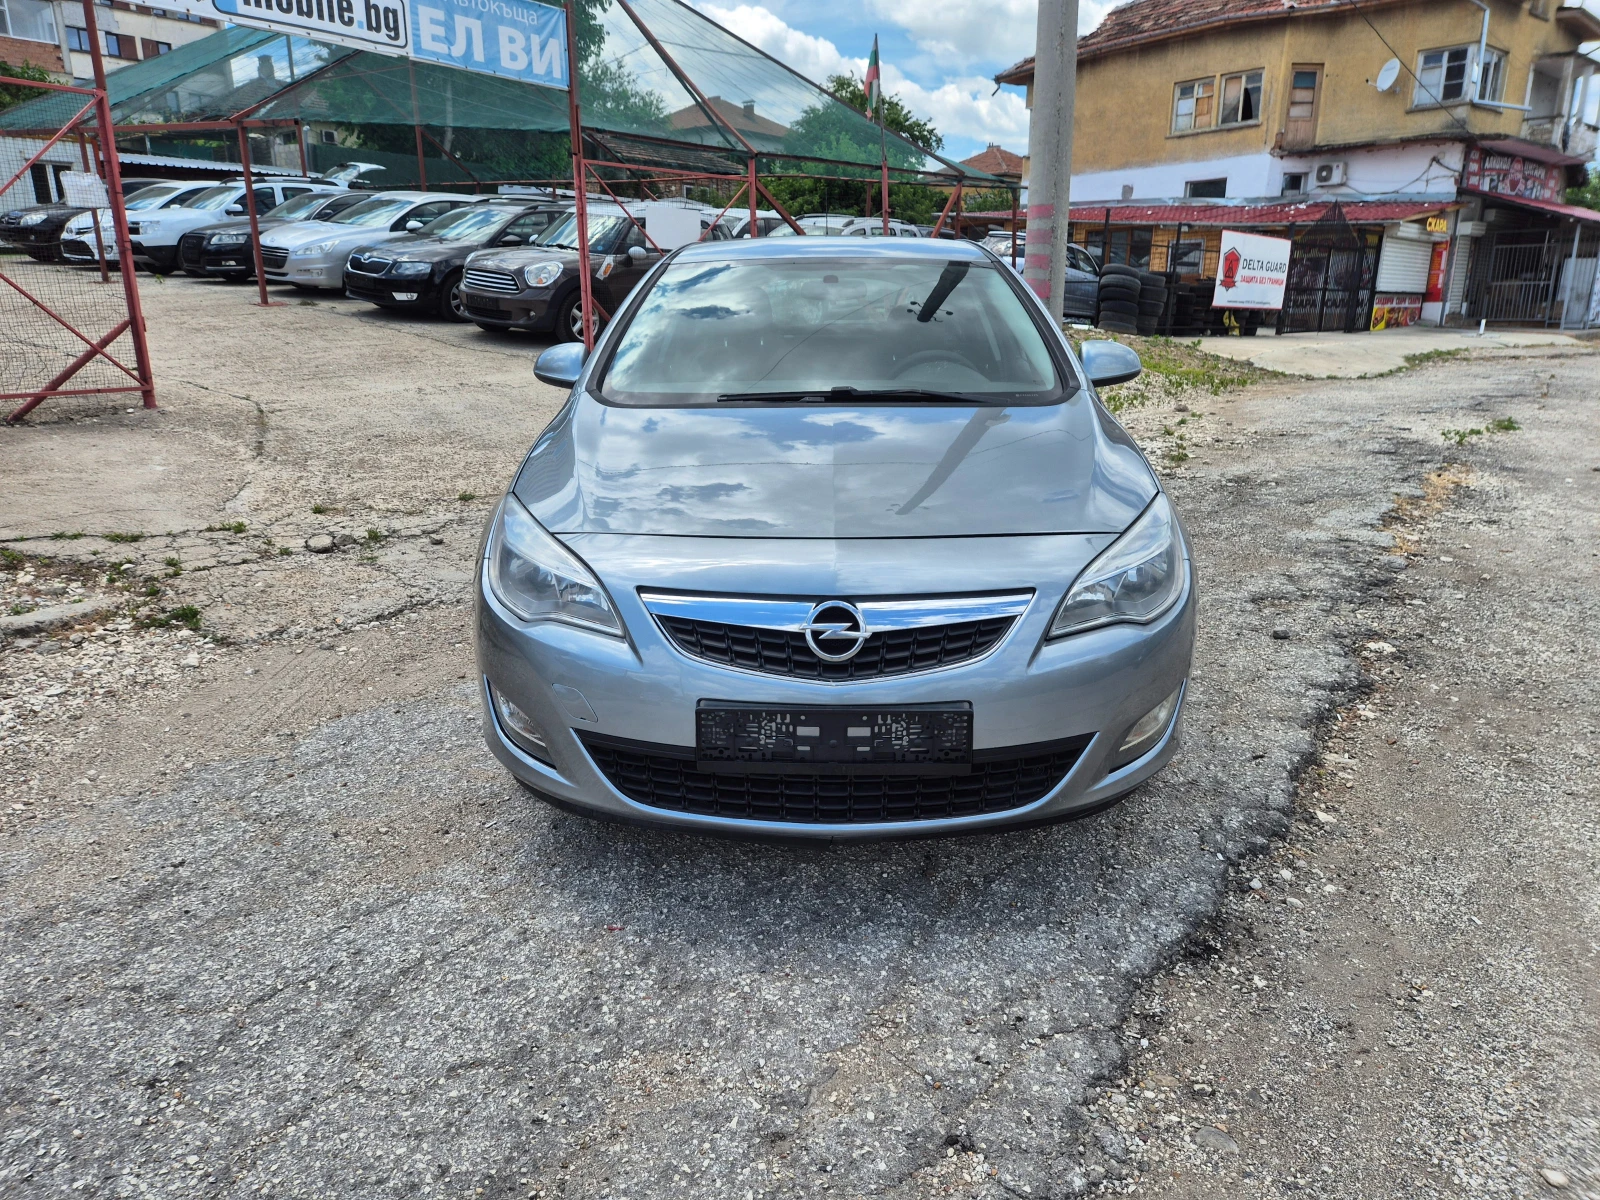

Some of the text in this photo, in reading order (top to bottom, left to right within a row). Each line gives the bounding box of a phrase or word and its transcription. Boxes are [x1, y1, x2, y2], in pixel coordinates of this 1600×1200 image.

[445, 0, 538, 26] втокъща
[418, 5, 562, 79] ЕЛ ВИ
[1426, 217, 1447, 233] СКАРА
[1242, 258, 1287, 273] DELTA GUARD
[1241, 275, 1258, 284] ЗАЩИТА
[1258, 276, 1267, 285] БЕЗ
